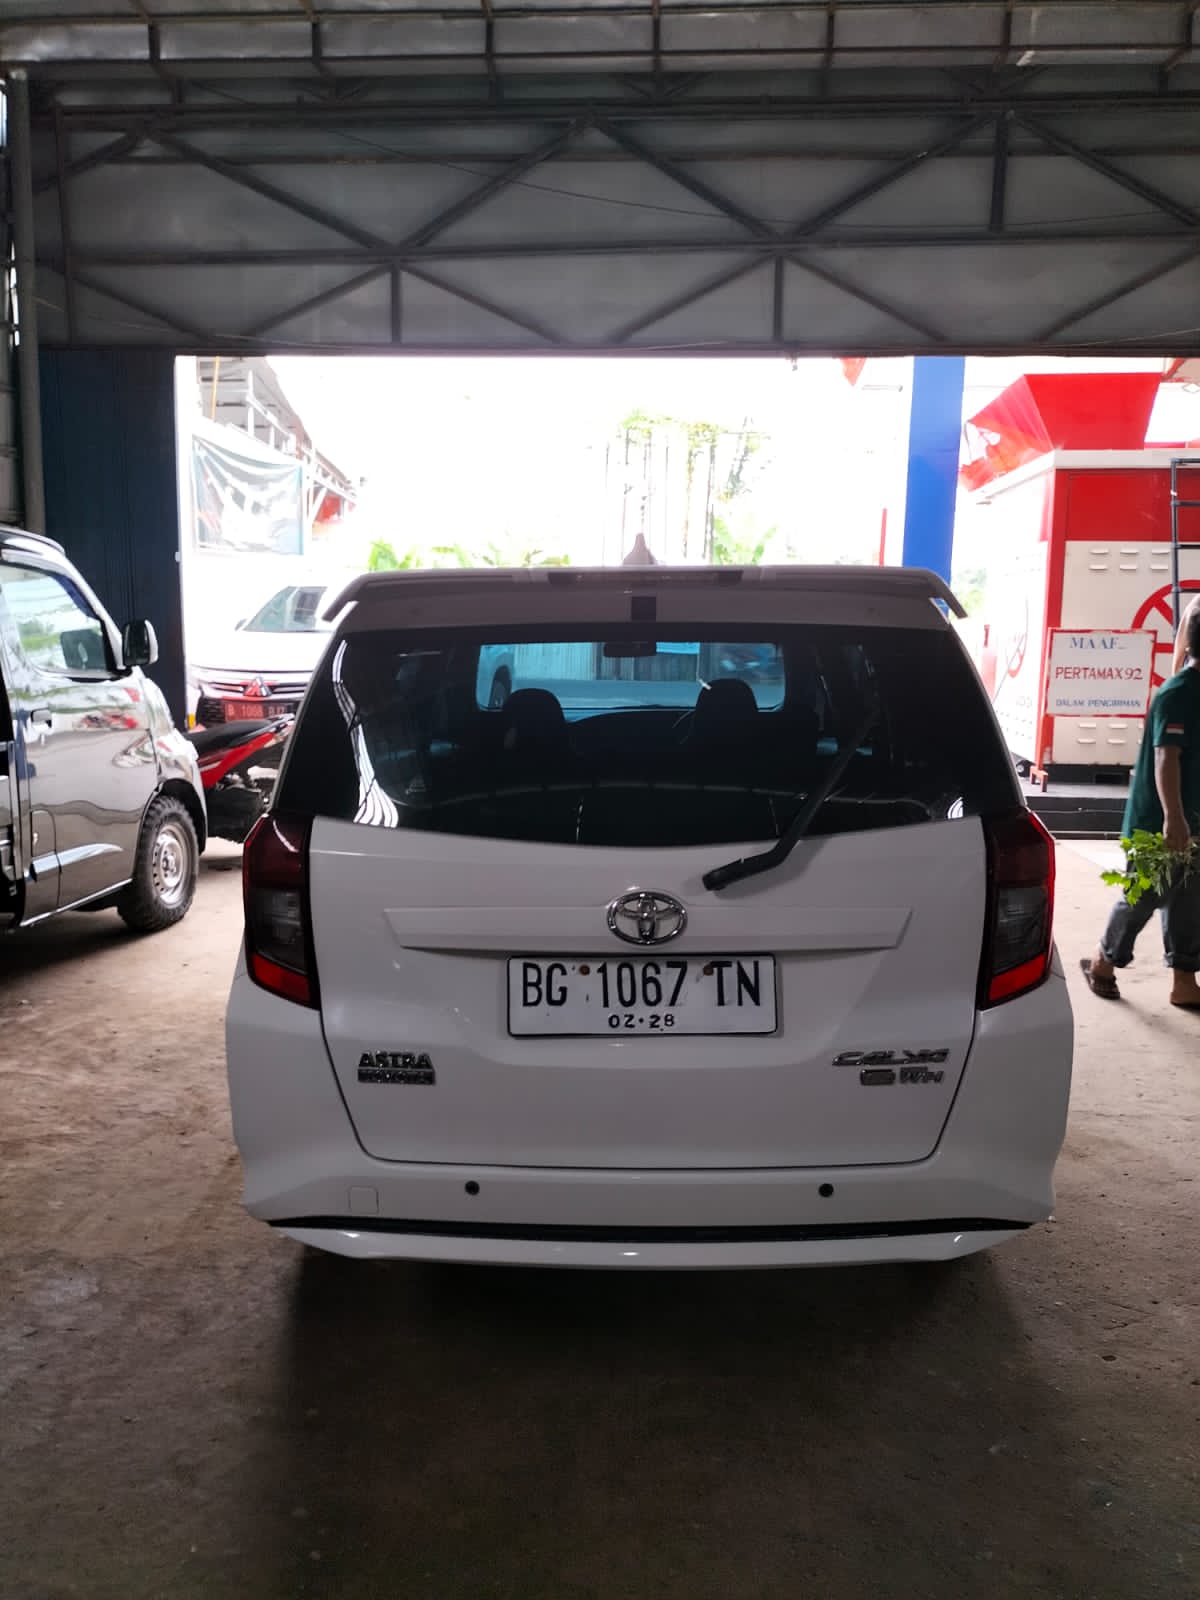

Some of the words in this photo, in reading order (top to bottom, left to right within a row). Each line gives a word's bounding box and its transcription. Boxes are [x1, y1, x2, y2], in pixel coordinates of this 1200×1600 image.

[1055, 666, 1123, 680] PERTAMAX
[521, 961, 568, 1007] BG
[597, 960, 688, 1008] 1067
[709, 960, 761, 1007] TN
